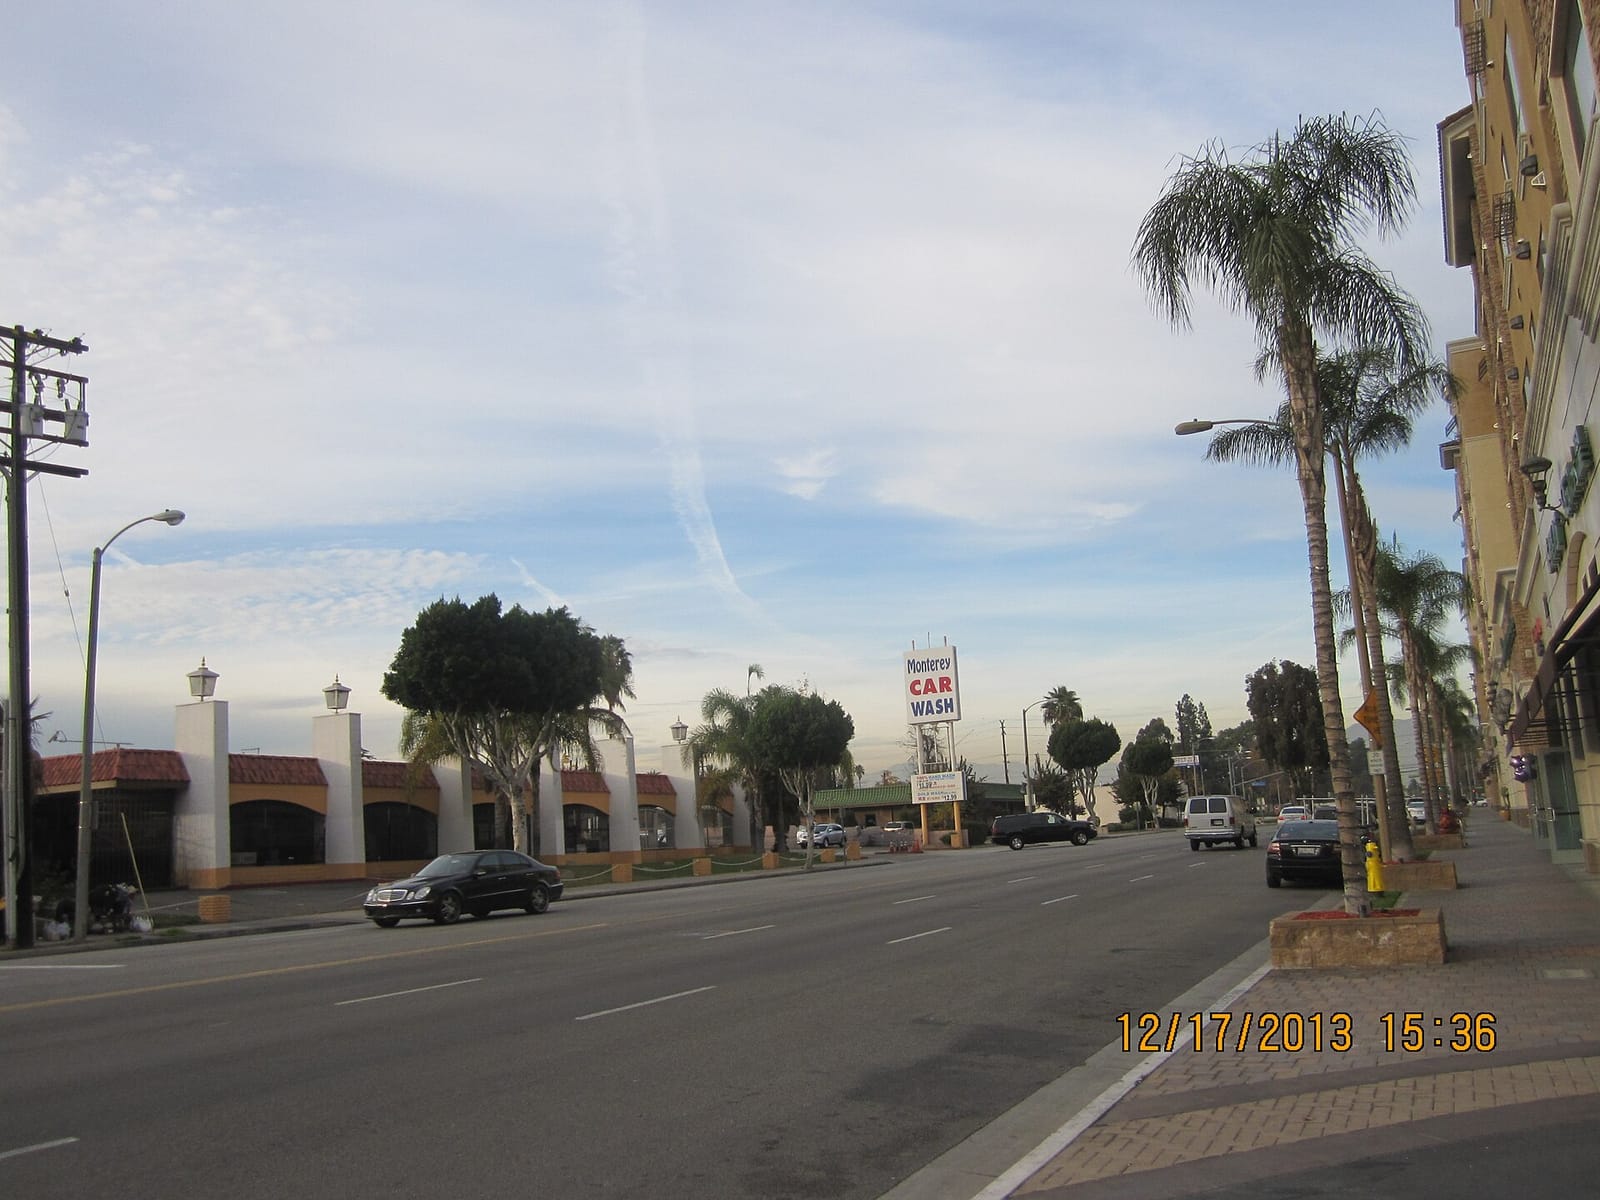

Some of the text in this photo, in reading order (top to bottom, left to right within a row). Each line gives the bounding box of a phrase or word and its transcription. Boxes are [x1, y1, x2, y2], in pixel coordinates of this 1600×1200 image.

[907, 657, 951, 674] Monterey
[909, 676, 953, 696] CAR
[910, 697, 954, 717] WASH
